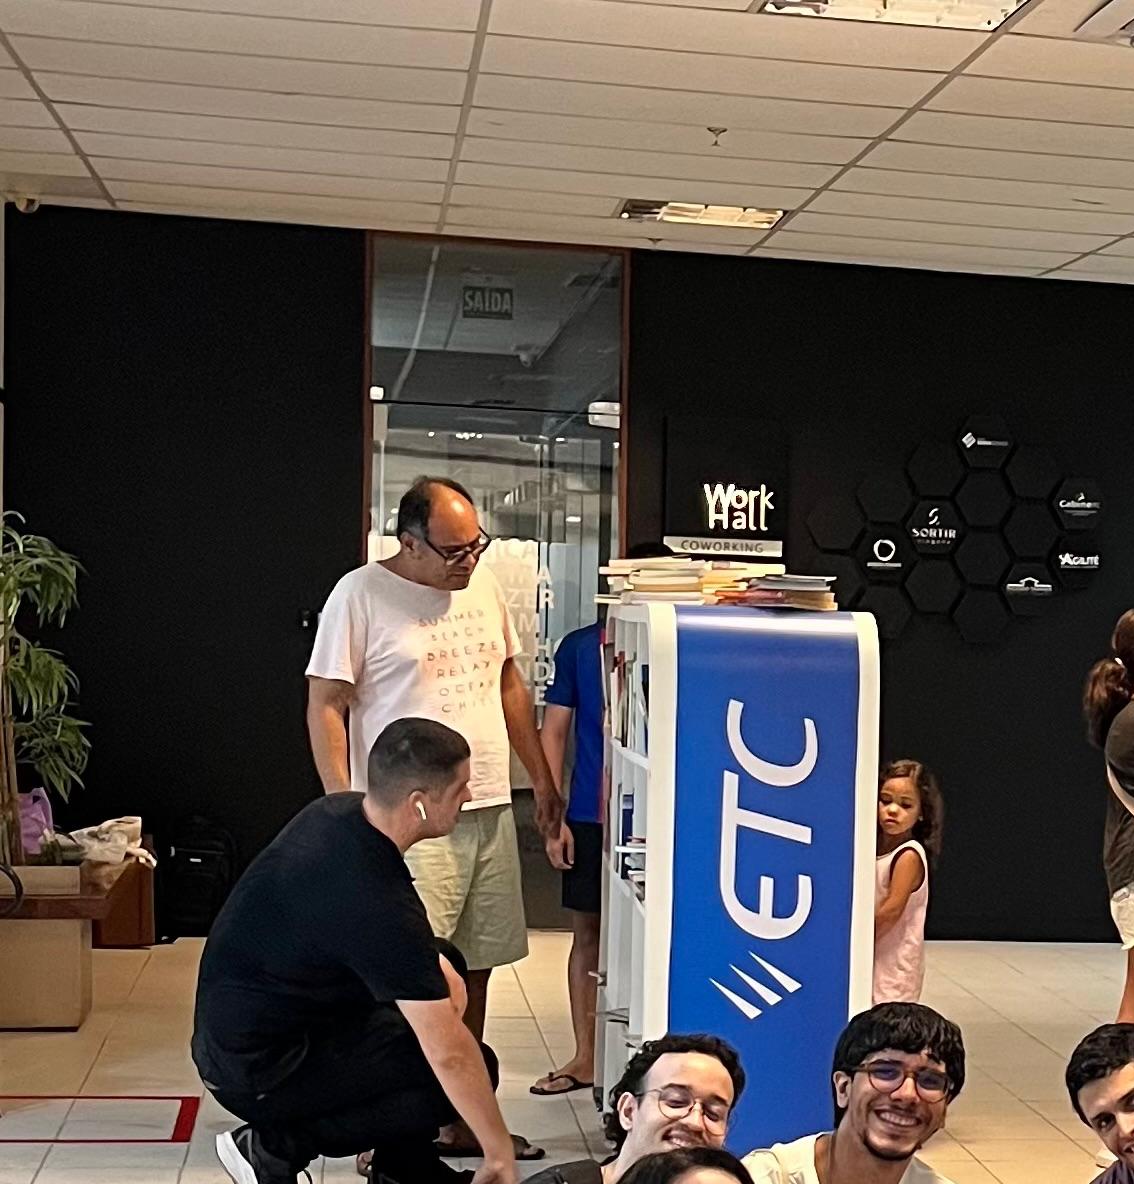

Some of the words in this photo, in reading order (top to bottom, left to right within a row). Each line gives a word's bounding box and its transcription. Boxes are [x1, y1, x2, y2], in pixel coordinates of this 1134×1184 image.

[704, 483, 775, 510] Work
[708, 506, 769, 531] Hall
[912, 528, 957, 539] SORTIR
[681, 539, 764, 553] COWORKING
[427, 641, 498, 661] BREEZE
[720, 699, 818, 940] ETC
